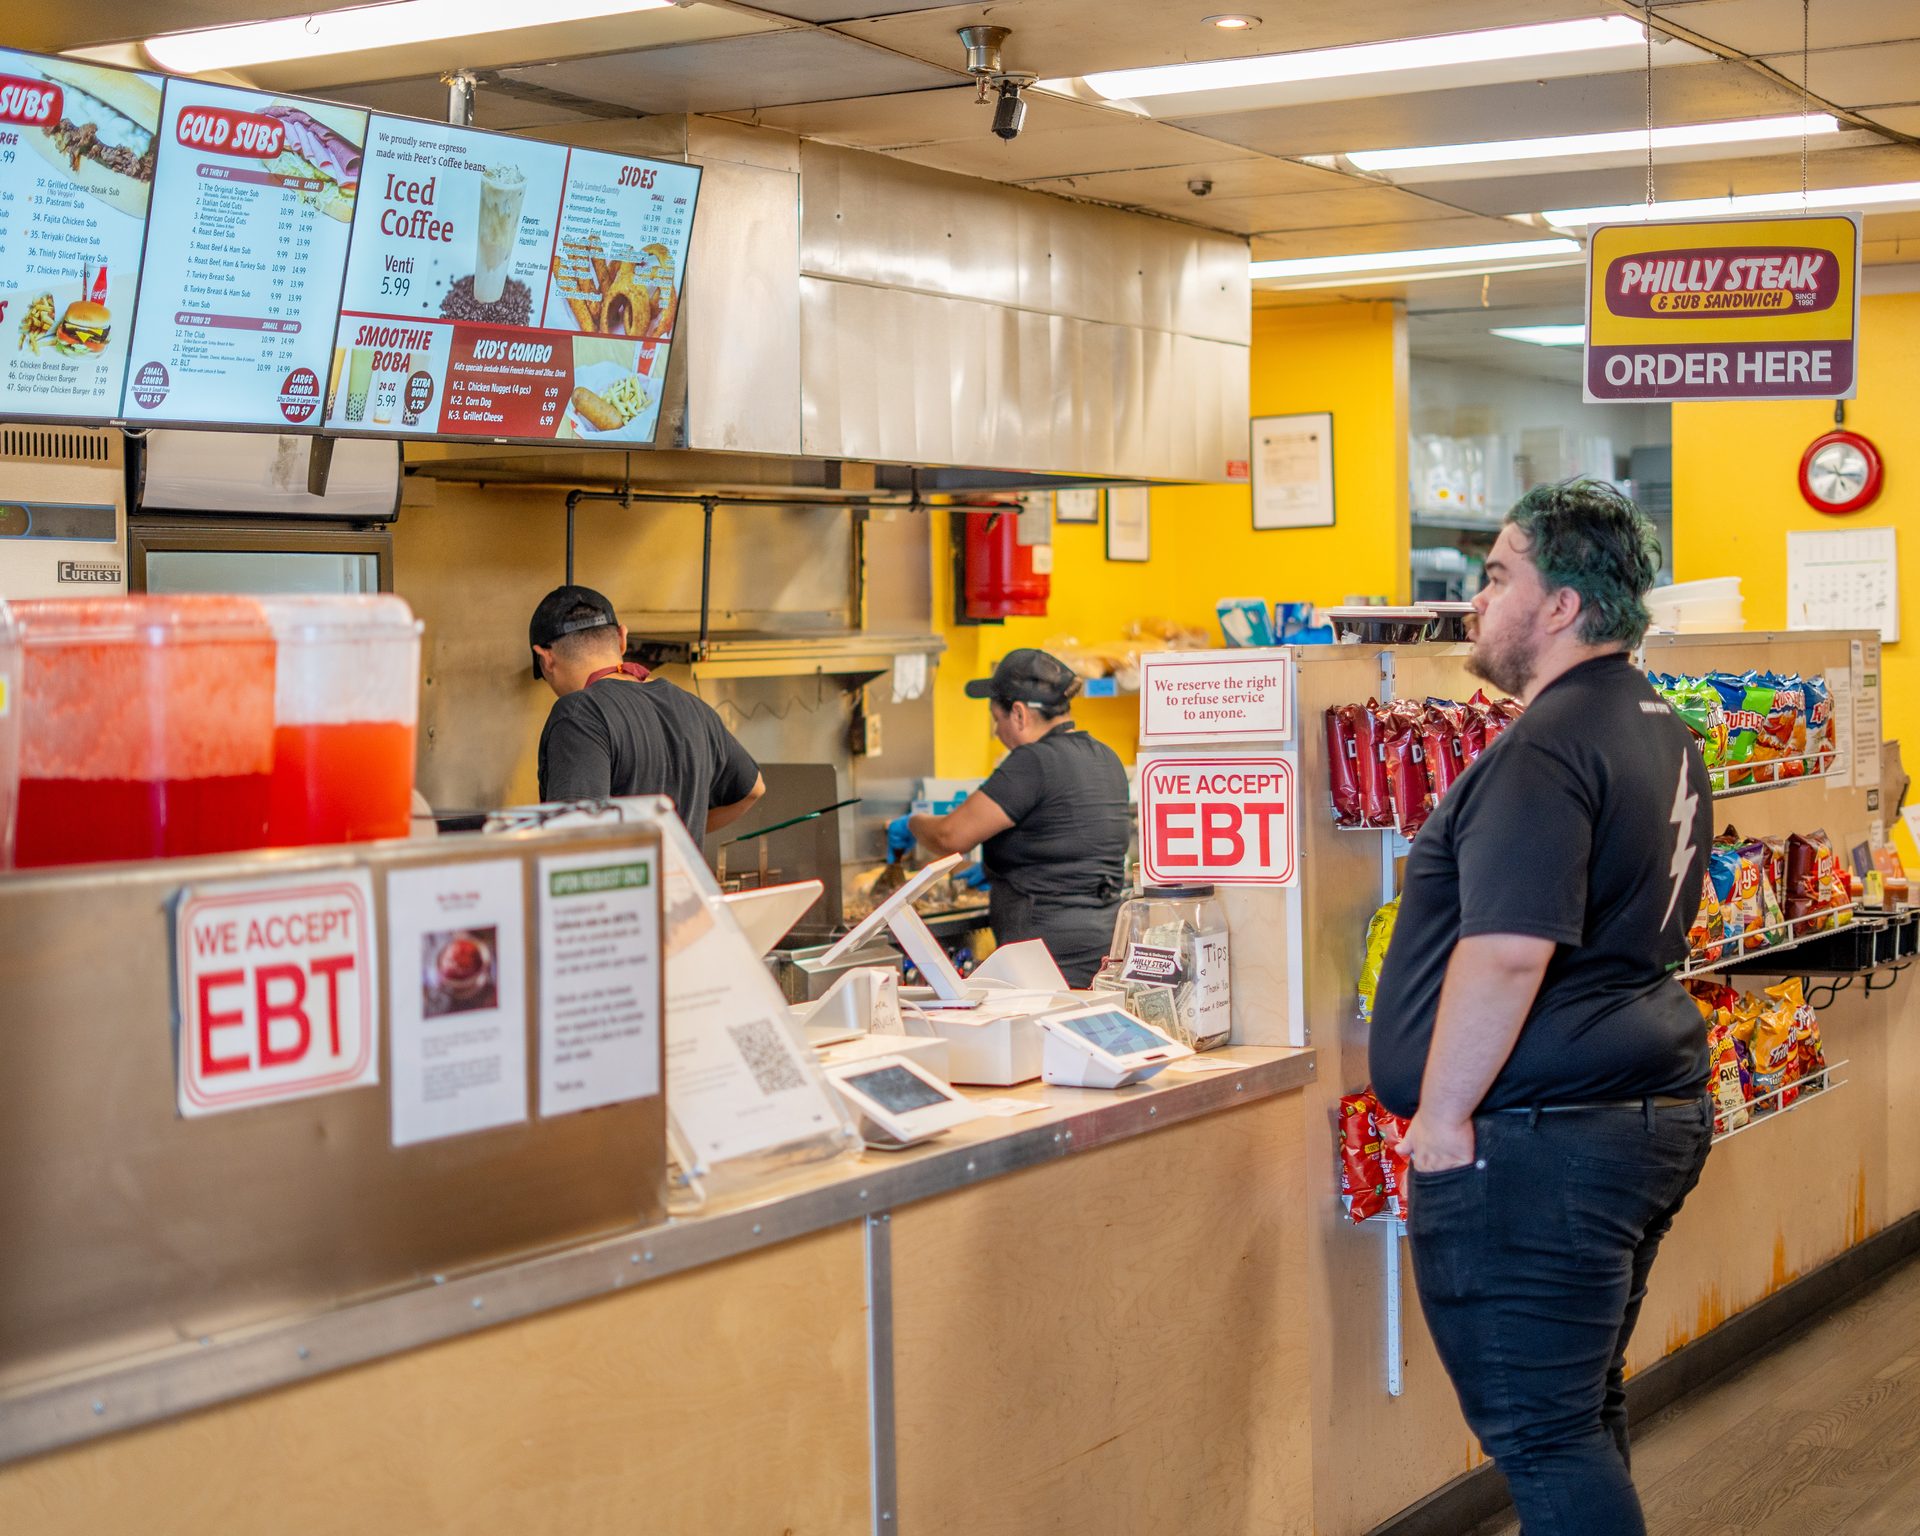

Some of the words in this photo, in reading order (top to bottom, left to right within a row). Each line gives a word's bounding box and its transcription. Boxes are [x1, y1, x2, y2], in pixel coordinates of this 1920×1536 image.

[0, 87, 54, 119] SUBS
[179, 113, 229, 145] COLD
[232, 121, 282, 153] SUBS
[378, 132, 389, 142] We
[390, 135, 418, 148] proudly
[418, 139, 437, 149] serve
[438, 142, 467, 155] espresso
[376, 149, 395, 159] made
[397, 151, 413, 163] with
[413, 153, 437, 166] Peet's
[438, 157, 462, 169] Coffee
[618, 166, 657, 190] SIDES
[37, 178, 46, 188] 32.
[47, 180, 68, 190] Grilled
[69, 183, 89, 193] Cheese
[90, 186, 107, 195] Steak
[108, 187, 120, 197] Sub
[384, 173, 436, 206] Iced
[34, 196, 44, 206] 33.
[46, 197, 72, 208] Pastrami
[73, 200, 85, 209] Sub
[32, 213, 42, 222] 34.
[43, 214, 61, 226] Fajita
[62, 216, 85, 227] Chicken
[86, 218, 98, 228] Sub
[380, 209, 454, 242] Coffee
[30, 230, 40, 239] 35.
[41, 231, 64, 242] Teriyaki
[65, 233, 88, 244] Chicken
[89, 236, 101, 245] Sub
[198, 227, 212, 236] Roast
[213, 229, 225, 238] Beef
[226, 231, 236, 239] Sub
[279, 236, 290, 245] 9.99
[296, 238, 311, 247] 13.99
[28, 248, 38, 256] 36.
[39, 249, 56, 260] Thinly
[58, 250, 76, 260] Sliced
[77, 252, 96, 263] Turkey
[97, 254, 108, 263] Sub
[385, 254, 414, 274] Venti
[26, 265, 36, 274] 37.
[37, 265, 60, 275] Chicken
[61, 268, 78, 278] Philly
[192, 271, 206, 282] Turkey
[207, 273, 224, 281] Breast
[225, 274, 235, 282] Sub
[272, 278, 284, 287] 9.99
[290, 280, 304, 289] 13.99
[1620, 258, 1724, 294] PHILLY
[1724, 255, 1824, 291] STEAK
[380, 276, 411, 297] 5.99
[188, 300, 200, 308] Ham
[200, 301, 211, 309] Sub
[268, 307, 279, 315] 9.99
[286, 308, 300, 317] 13.99
[1657, 296, 1668, 309] &
[1672, 294, 1701, 309] SUB
[1704, 292, 1783, 309] SANDWICH
[355, 325, 433, 351] SMOOTHIE
[473, 338, 508, 361] KID'S
[508, 342, 553, 364] COMBO
[10, 360, 19, 369] 45.
[20, 361, 41, 370] Chicken
[42, 362, 60, 371] Breast
[61, 363, 79, 373] Burger
[96, 365, 108, 374] 8.99
[371, 350, 411, 373] BOBA
[1604, 353, 1729, 386] ORDER
[1736, 350, 1832, 383] HERE
[8, 372, 17, 380] 46.
[18, 372, 35, 383] Crispy
[36, 373, 57, 382] Chicken
[58, 374, 77, 384] Burger
[94, 376, 107, 385] 7.99
[144, 367, 163, 376] SMALL
[292, 374, 314, 385] LARGE
[142, 376, 163, 385] COMBO
[289, 383, 313, 395] COMBO
[379, 382, 387, 391] 24
[388, 383, 396, 391] OZ
[411, 377, 431, 388] EXTRA
[453, 381, 465, 391] K-1.
[468, 382, 490, 392] Chicken
[491, 383, 511, 394] Nugget
[512, 384, 519, 393] (4
[519, 385, 532, 395] pcs)
[545, 388, 558, 397] 6.99
[6, 383, 16, 392] 47.
[17, 384, 32, 394] Spicy
[32, 385, 49, 395] Crispy
[50, 386, 72, 394] Chicken
[72, 387, 90, 397] Burger
[93, 388, 105, 396] 8.99
[139, 394, 152, 403] ADD
[152, 394, 161, 403] $5
[411, 387, 428, 398] BOBA
[377, 395, 397, 408] 5.99
[451, 395, 462, 405] K-2.
[466, 396, 479, 406] Corn
[480, 397, 492, 408] Dog
[542, 402, 556, 411] 6.99
[285, 405, 300, 415] ADD
[301, 405, 311, 416] $7
[448, 410, 460, 420] K-3.
[463, 411, 482, 421] Grilled
[483, 412, 504, 422] Cheese
[540, 416, 554, 425] 6.99
[1155, 679, 1173, 691] We
[1177, 680, 1220, 691] reserve
[1224, 677, 1243, 690] the
[1246, 675, 1277, 692] right
[1166, 695, 1178, 706] to
[1181, 693, 1219, 706] refuse
[1222, 691, 1265, 704] service
[1184, 709, 1195, 720] to
[1199, 708, 1246, 723] anyone.
[1154, 775, 1190, 795] WE
[1196, 774, 1283, 795] ACCEPT
[1155, 803, 1284, 867] EBT
[195, 922, 238, 957] WE
[245, 909, 352, 951] ACCEPT
[1203, 943, 1227, 968] Tips
[1151, 960, 1171, 969] STEAK
[197, 954, 355, 1079] EBT
